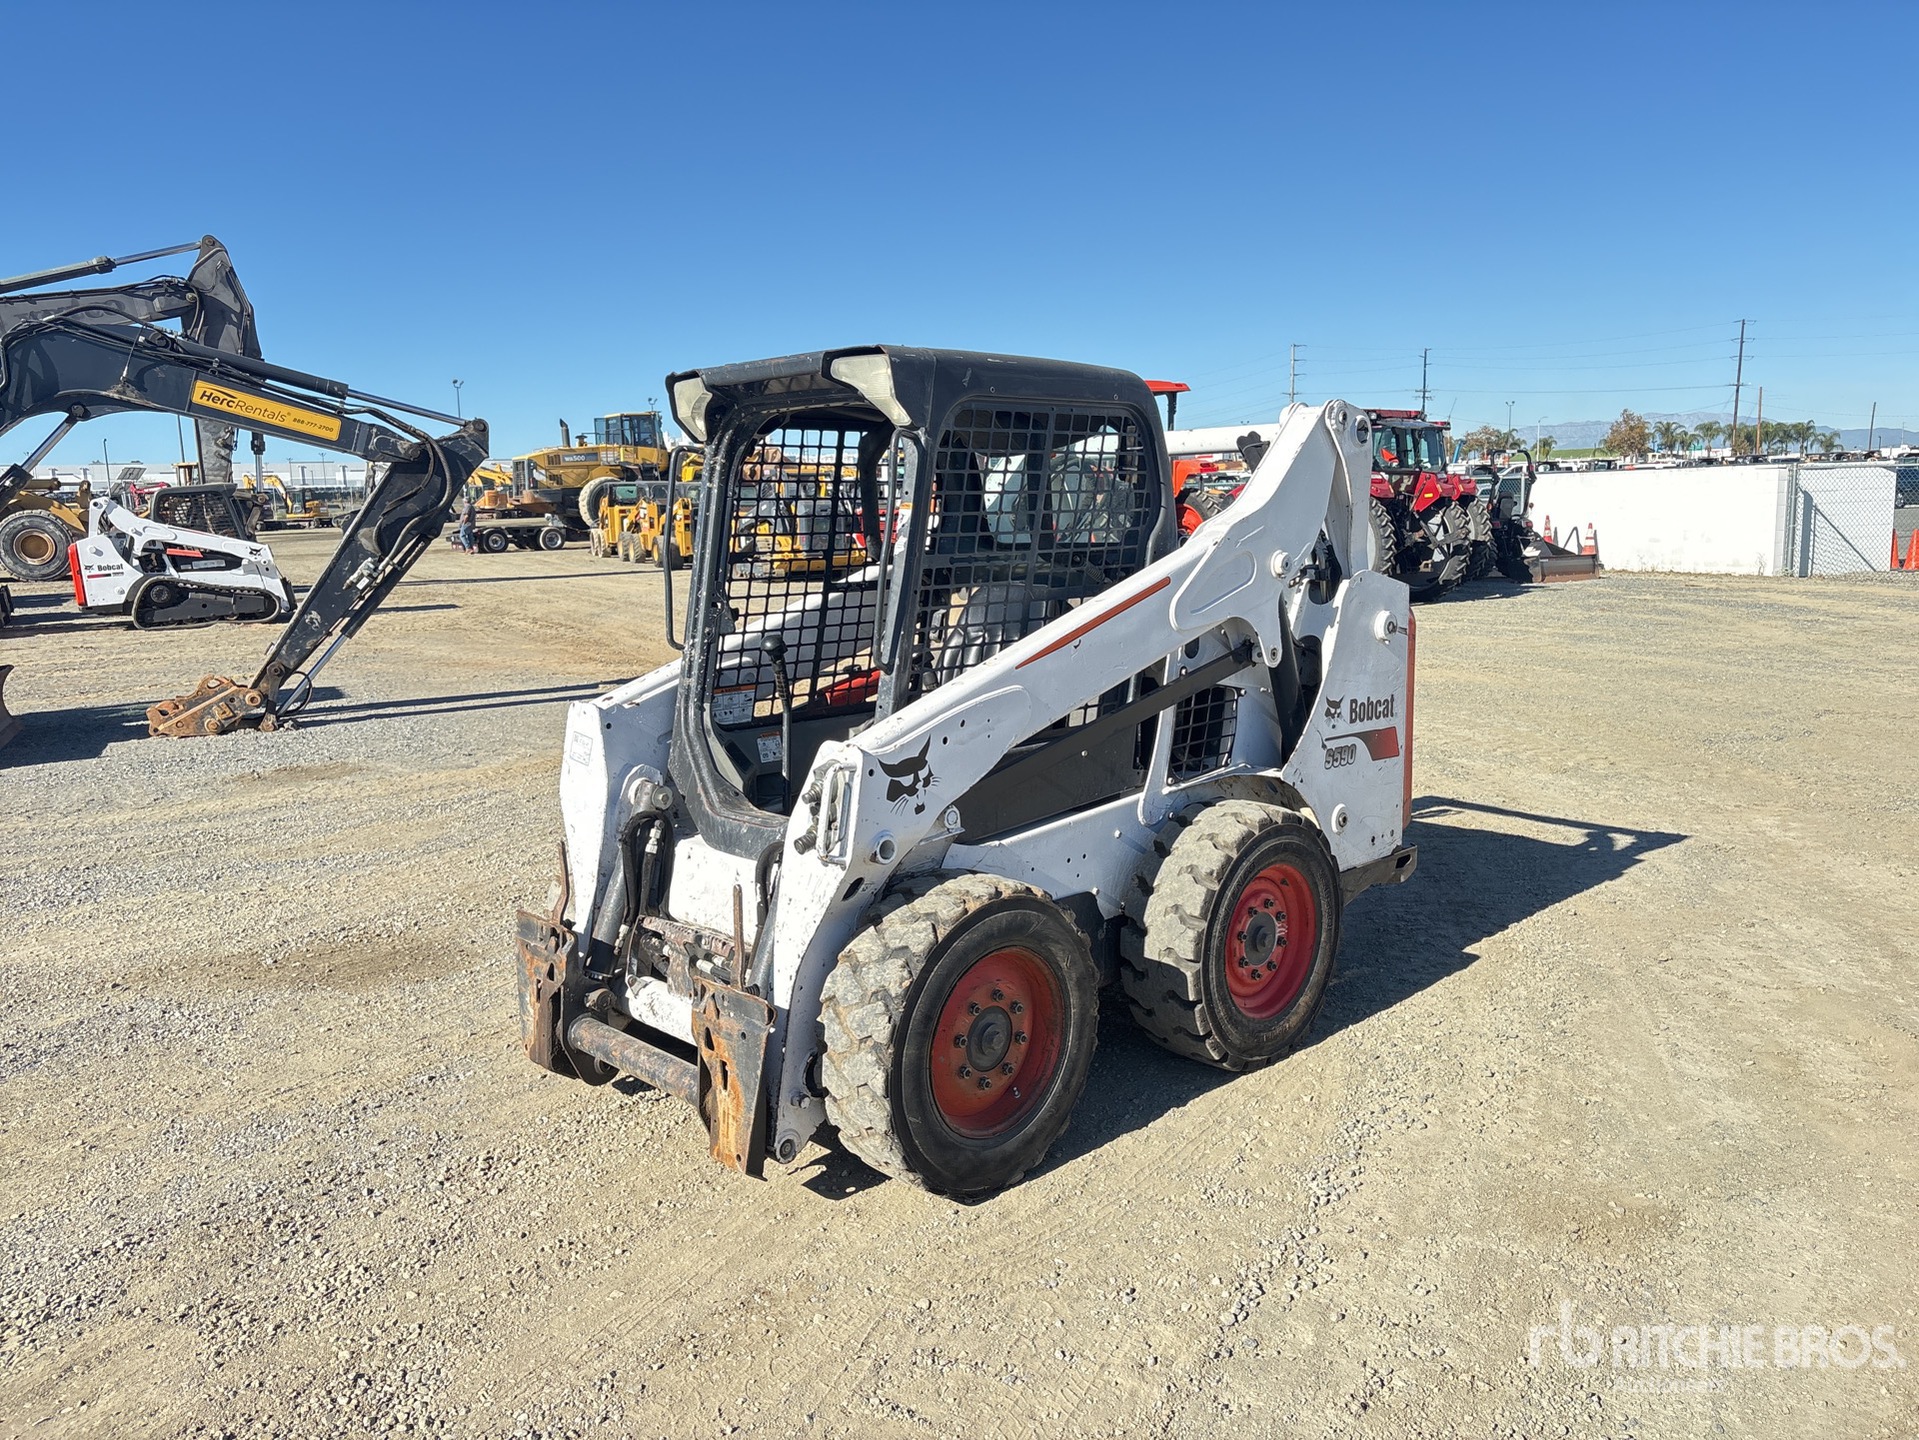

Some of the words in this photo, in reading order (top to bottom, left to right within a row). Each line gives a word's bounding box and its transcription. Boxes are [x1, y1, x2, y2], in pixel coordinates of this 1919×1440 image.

[292, 417, 334, 433] 888-777-2700
[97, 563, 124, 572] Bobcat
[1349, 694, 1395, 724] Bobcat
[1324, 744, 1357, 770] S590
